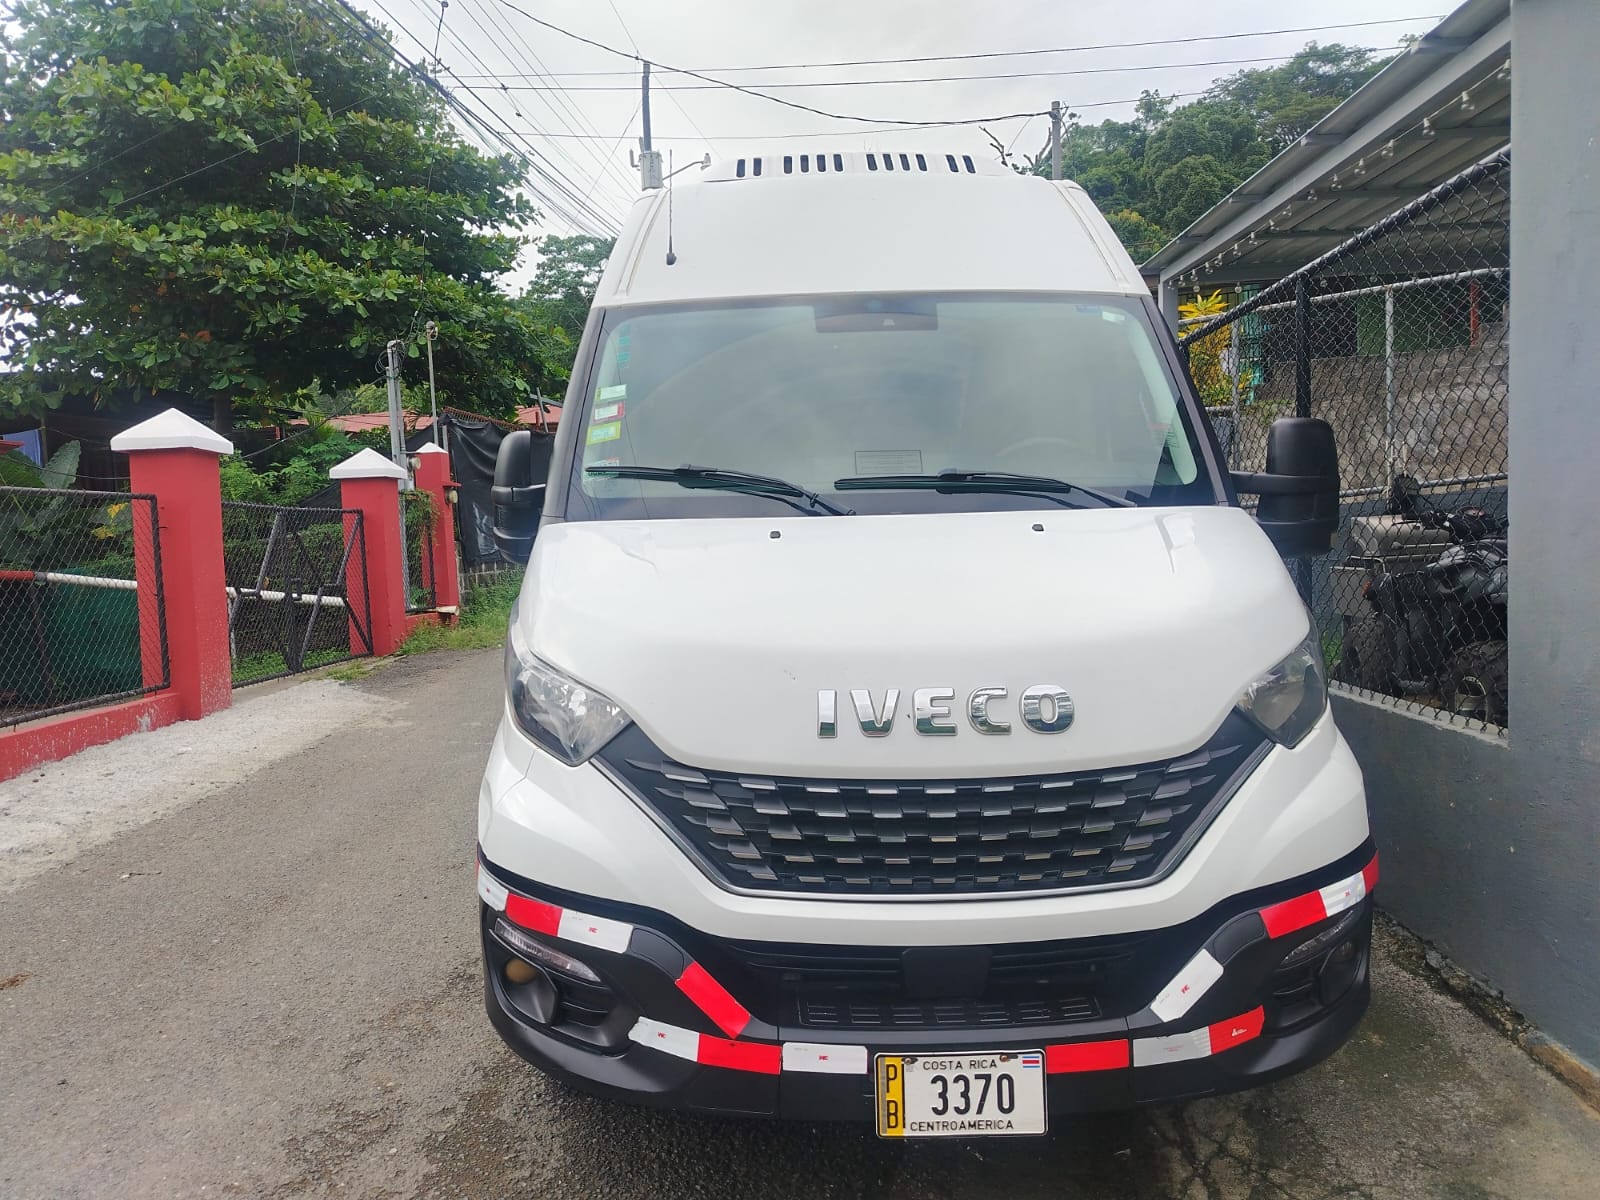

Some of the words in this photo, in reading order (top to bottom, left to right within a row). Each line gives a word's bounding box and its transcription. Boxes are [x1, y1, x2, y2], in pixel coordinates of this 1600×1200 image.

[817, 684, 1075, 738] IVECO
[923, 1060, 963, 1071] COSTA
[969, 1059, 998, 1070] RICA
[930, 1073, 1015, 1116] 3370
[910, 1120, 1014, 1132] CENTROAMERICA
